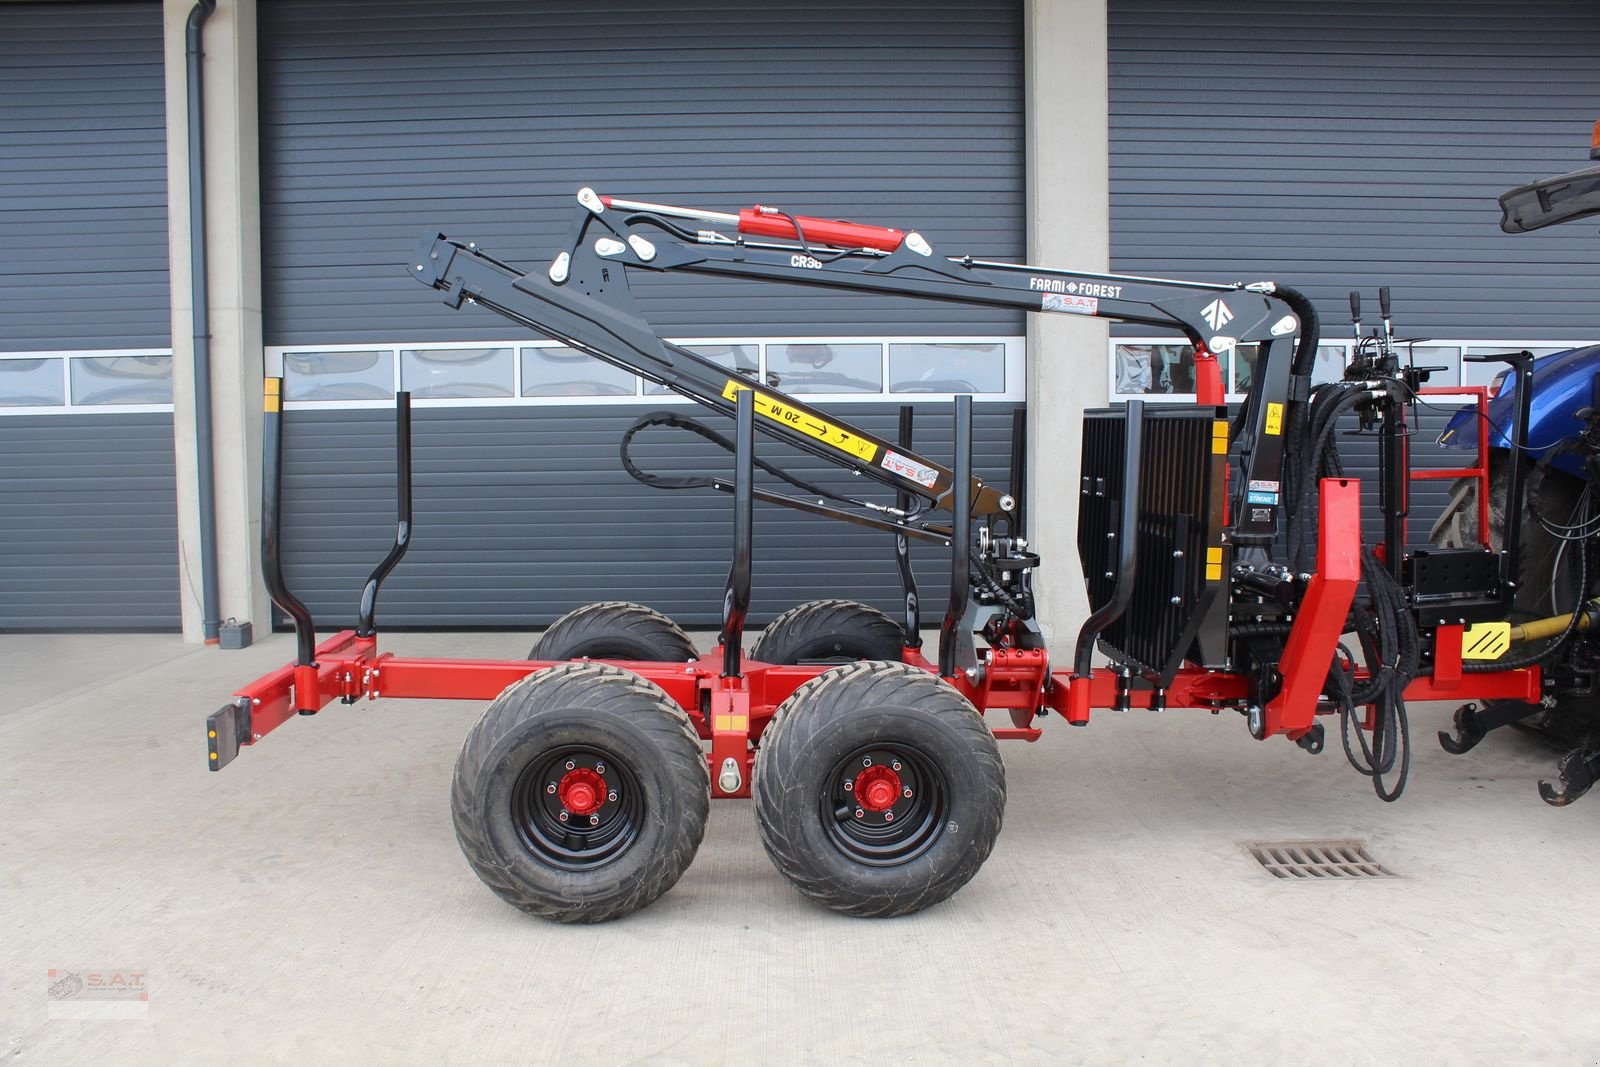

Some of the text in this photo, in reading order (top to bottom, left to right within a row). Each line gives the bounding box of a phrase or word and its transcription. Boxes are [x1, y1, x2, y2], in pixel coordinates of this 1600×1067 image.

[1030, 277, 1122, 298] FARMI FOREST
[1063, 297, 1097, 308] S.A.T.
[770, 404, 800, 424] 20 M
[884, 457, 917, 477] S.A.T.
